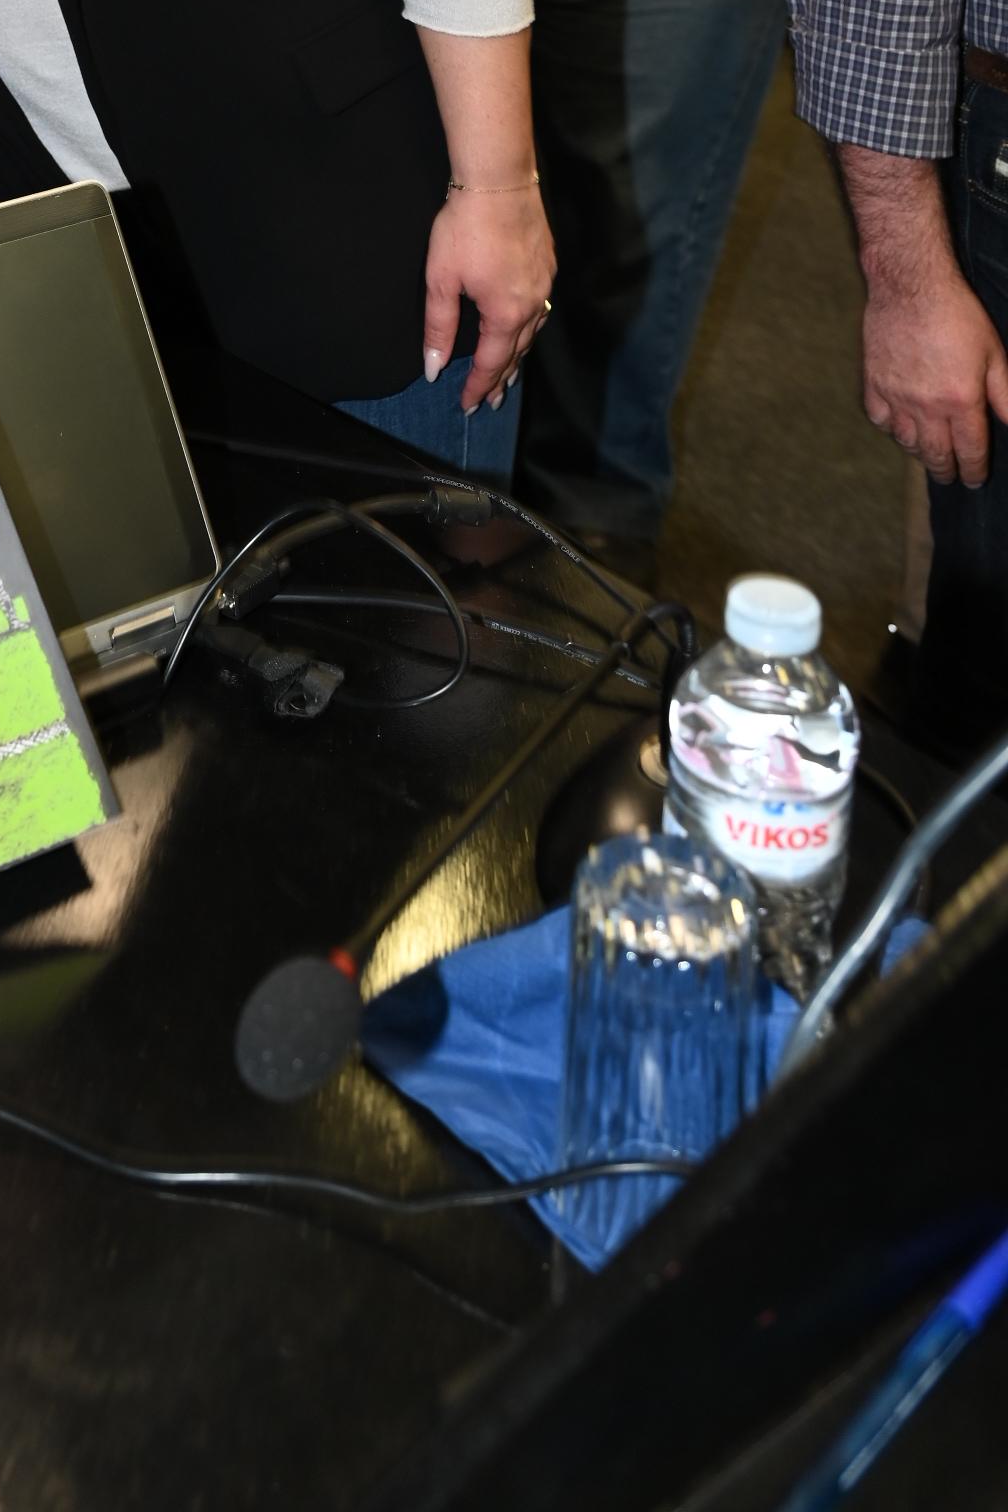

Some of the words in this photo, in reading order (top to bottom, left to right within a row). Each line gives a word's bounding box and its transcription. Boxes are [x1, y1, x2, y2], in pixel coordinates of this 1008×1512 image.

[423, 475, 476, 492] PROFESSIONAL
[479, 489, 498, 500] LOW
[499, 498, 518, 513] NOISE
[560, 545, 582, 563] CABLE
[724, 813, 829, 851] VIKOS
